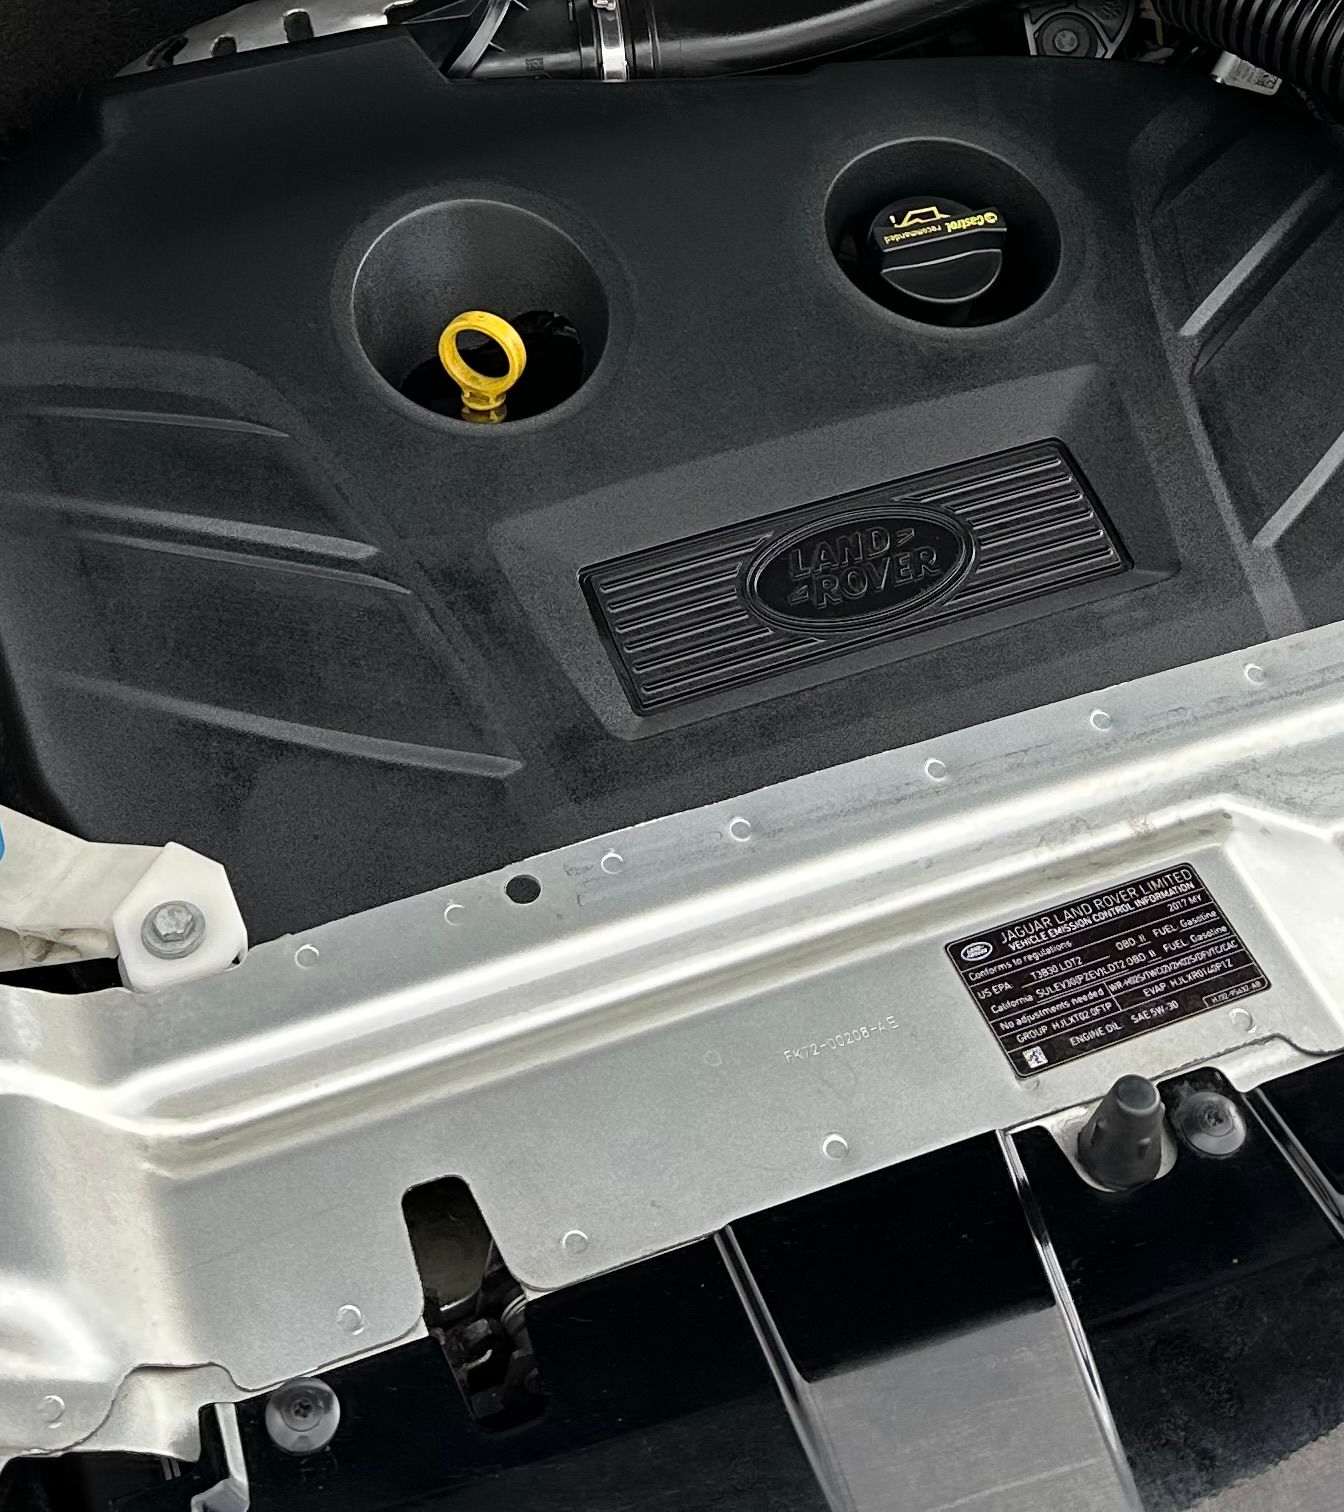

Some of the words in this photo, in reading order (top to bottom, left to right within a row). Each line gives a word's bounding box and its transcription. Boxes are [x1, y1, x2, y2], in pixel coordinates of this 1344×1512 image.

[883, 224, 942, 244] recommended
[944, 214, 985, 232] Castrol
[789, 526, 893, 579] LAND
[816, 547, 941, 609] ROVER
[1000, 916, 1053, 944] JAGUAR
[1053, 902, 1093, 924] LAND
[1092, 886, 1139, 910] ROVER
[1138, 868, 1192, 895] LIMITED
[1007, 931, 1049, 951] VEHICLE
[1047, 916, 1092, 938] EMISSION
[1091, 902, 1135, 922] CONTROL
[1133, 881, 1195, 907] INFORMATION
[1166, 898, 1187, 912] 2017
[1187, 893, 1202, 904] MY
[976, 987, 992, 999] US
[1058, 956, 1083, 970] LDT2
[1179, 910, 1217, 928] Gasoline
[1189, 925, 1227, 943] Gasoline
[968, 961, 1013, 981] Conforms
[1011, 957, 1023, 966] to
[1022, 940, 1072, 962] regulations
[999, 1020, 1015, 1030] No
[1015, 1000, 1071, 1026] adjustments
[1070, 987, 1105, 1005] needed
[1068, 1026, 1106, 1046] ENGINE
[1130, 1009, 1151, 1023] SAE
[1149, 999, 1179, 1016] 5W-30
